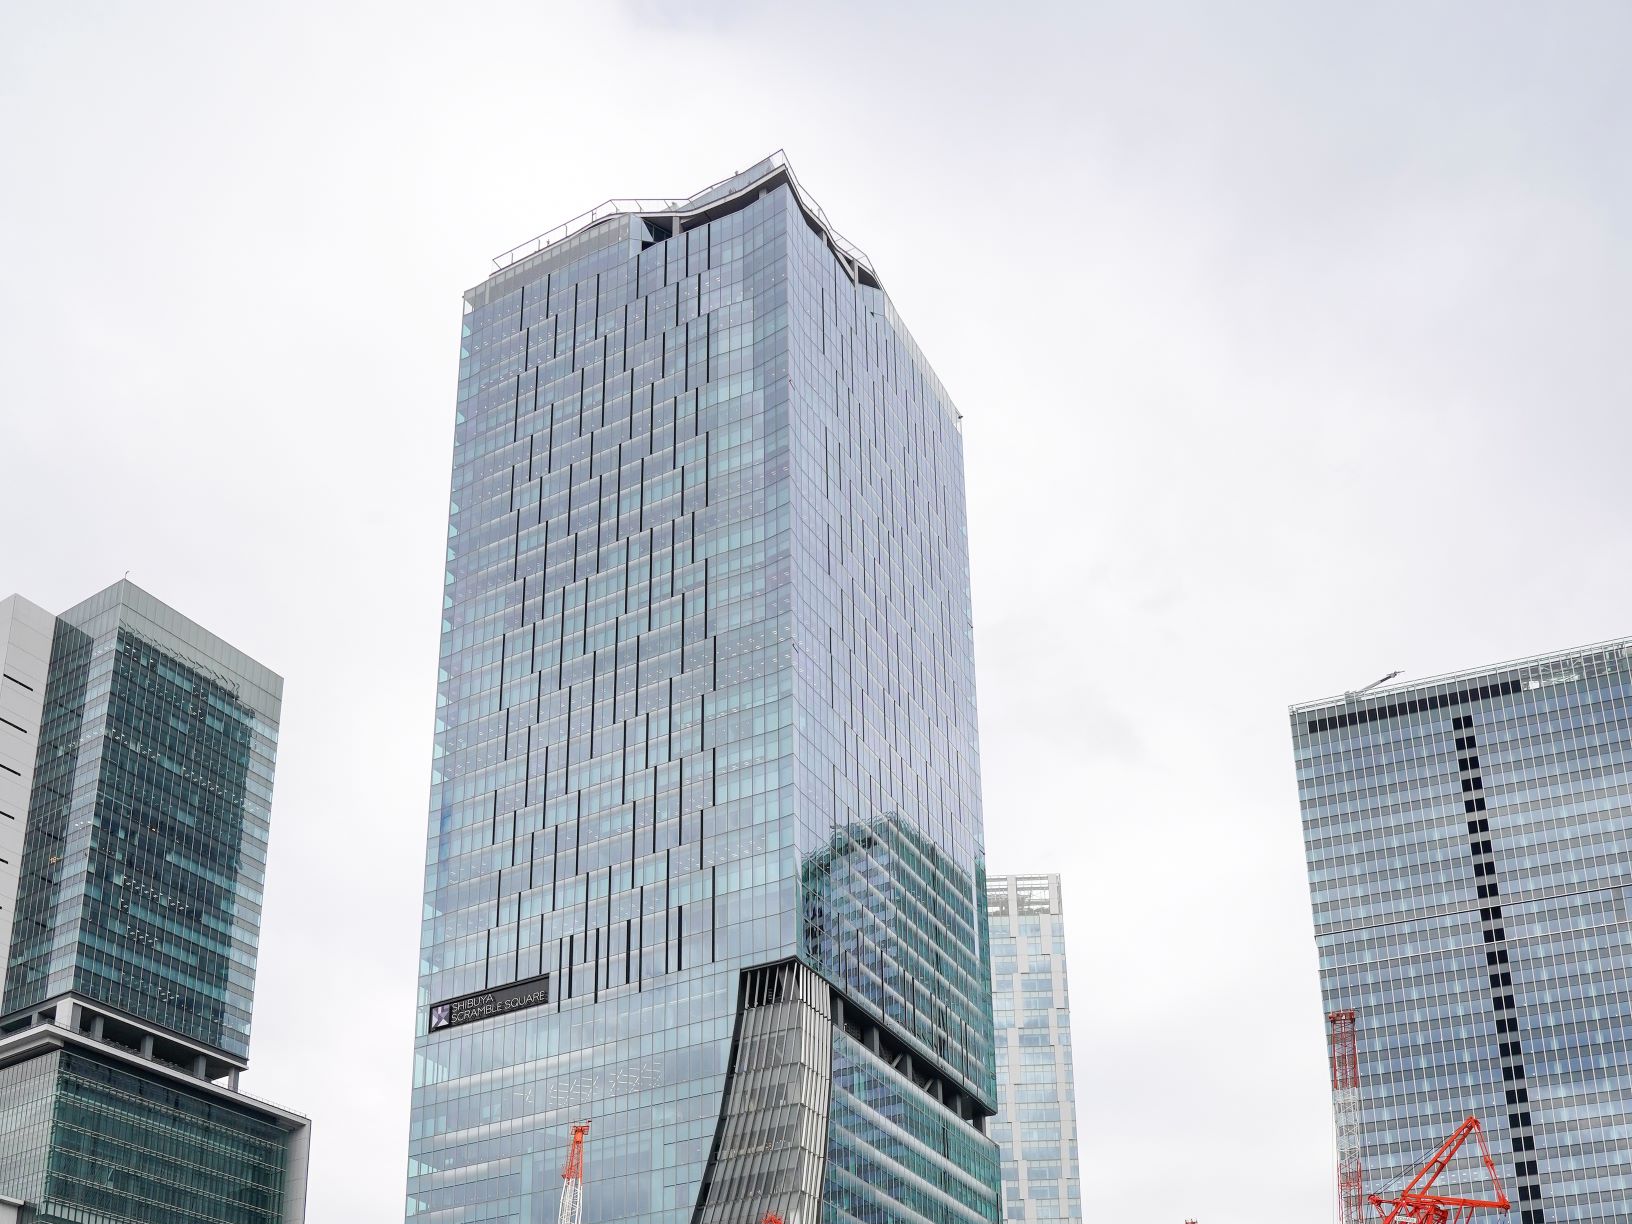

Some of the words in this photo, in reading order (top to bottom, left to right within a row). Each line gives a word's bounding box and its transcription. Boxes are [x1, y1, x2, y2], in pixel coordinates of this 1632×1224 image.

[451, 1002, 502, 1022] SCRAMBLE
[504, 991, 545, 1009] SQUARE
[452, 994, 493, 1012] SHIBUYA
